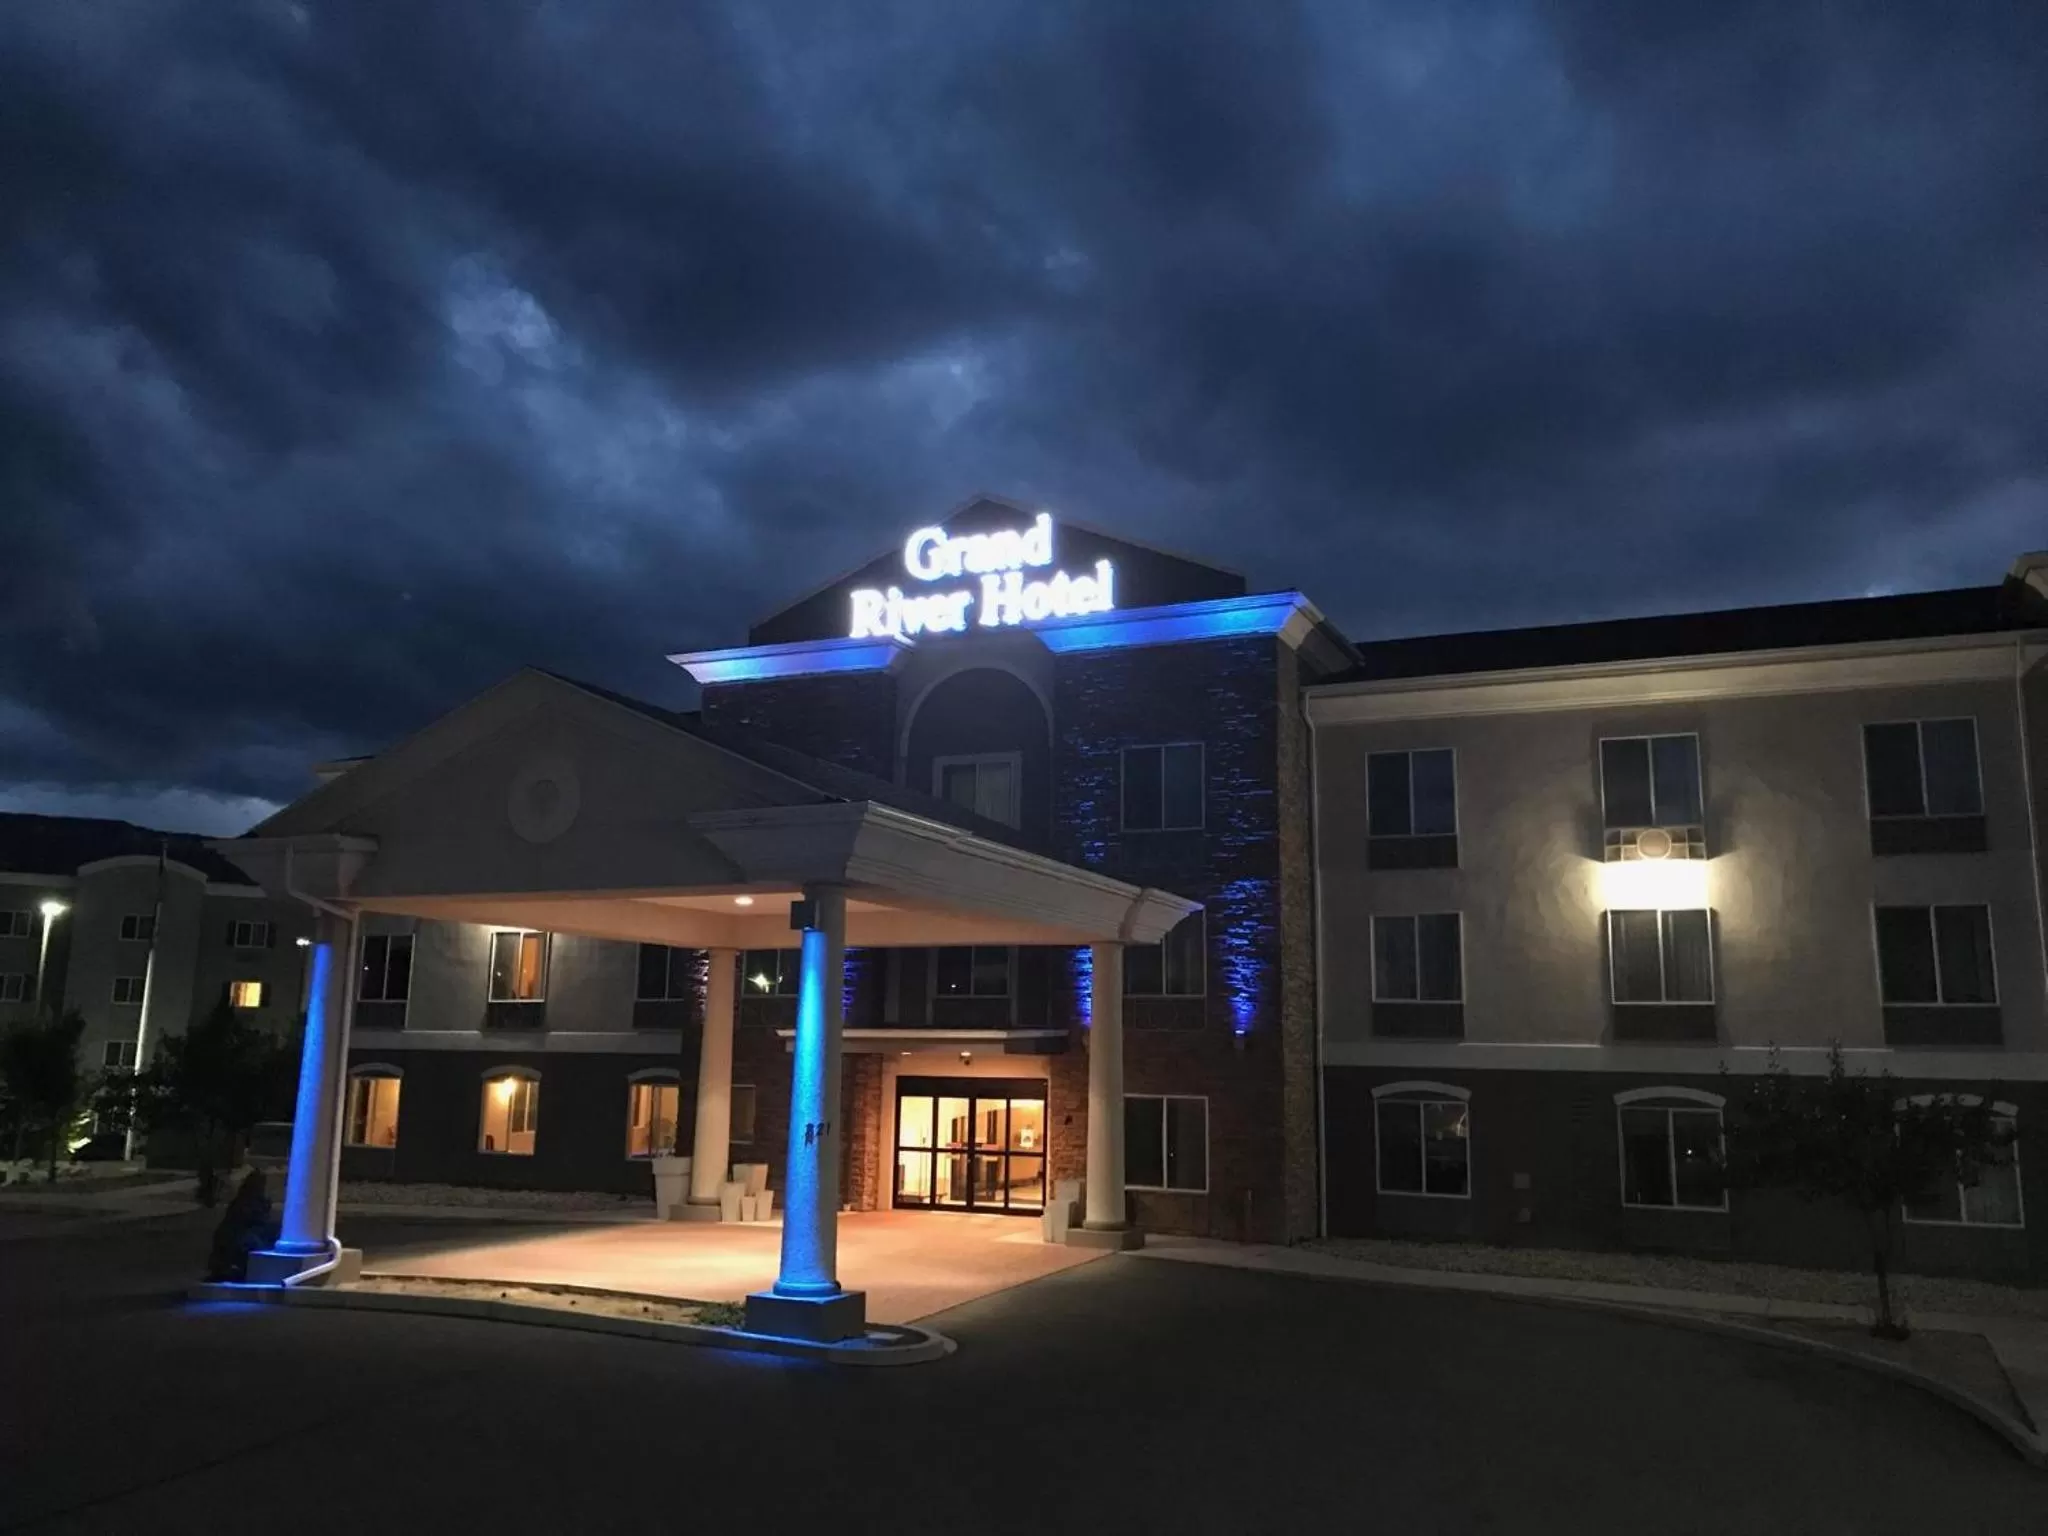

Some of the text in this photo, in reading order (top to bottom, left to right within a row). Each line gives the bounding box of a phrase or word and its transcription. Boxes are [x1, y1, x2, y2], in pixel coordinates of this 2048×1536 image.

[904, 512, 1052, 581] Grand
[850, 558, 1115, 638] River Hotel
